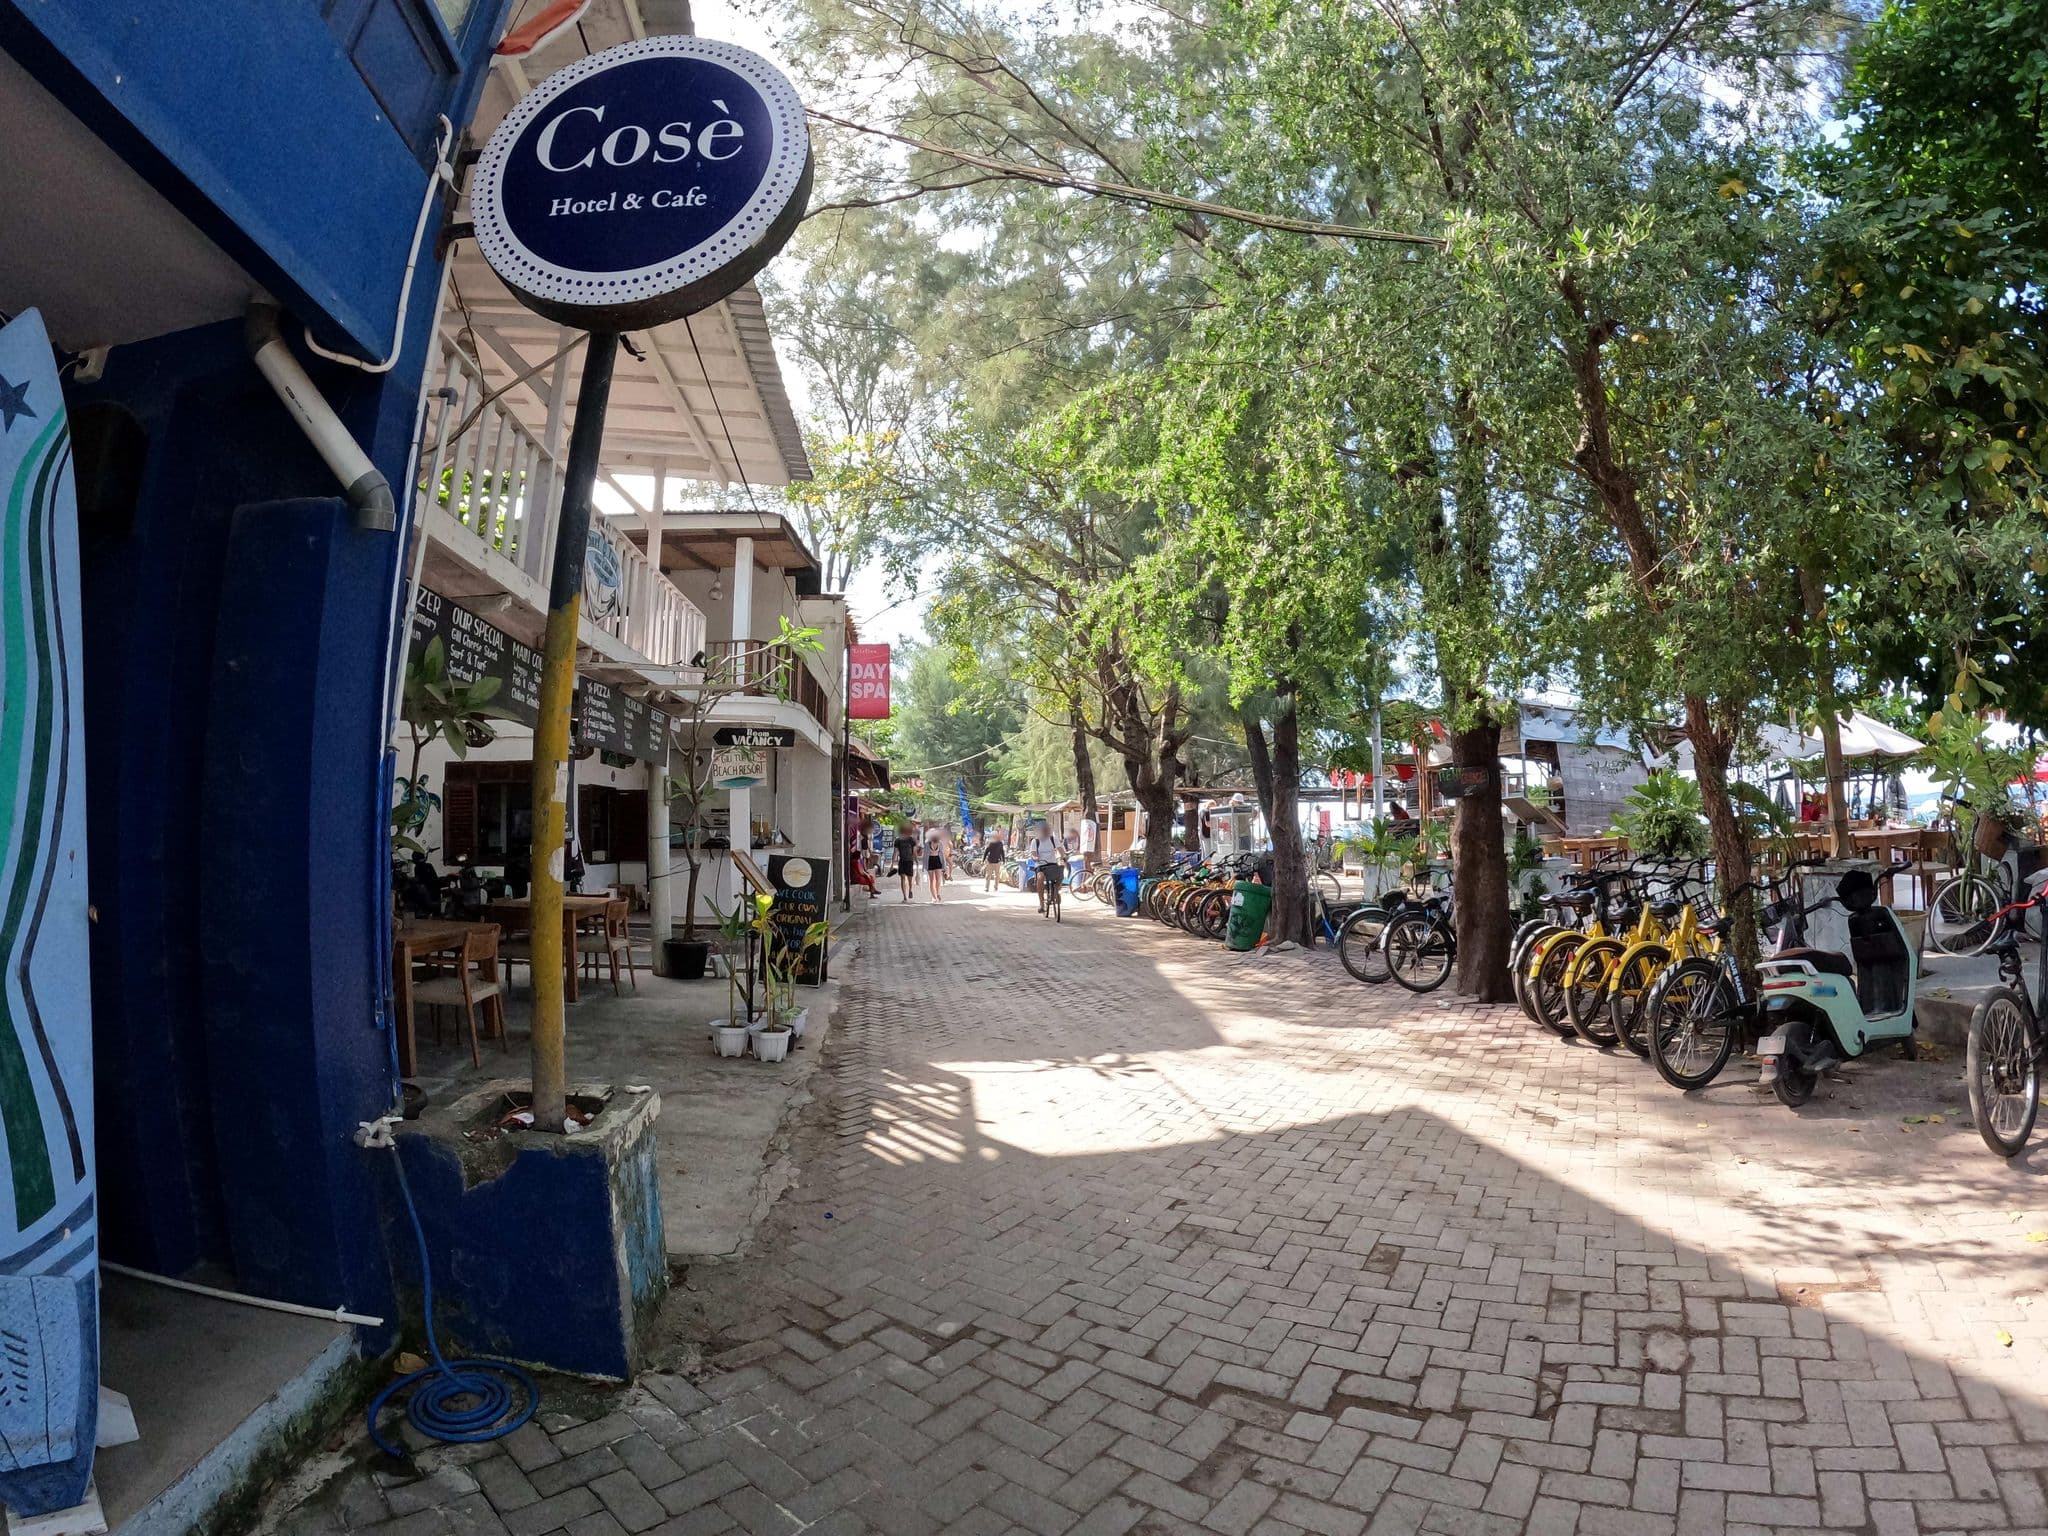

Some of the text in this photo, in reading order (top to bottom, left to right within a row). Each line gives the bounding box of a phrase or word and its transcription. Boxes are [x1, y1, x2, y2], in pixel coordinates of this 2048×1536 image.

[536, 99, 744, 173] Cosè
[549, 186, 708, 217] Hotel & Cafe
[452, 606, 505, 652] OUR SPECIAL
[450, 643, 466, 661] Surf
[466, 651, 473, 666] &
[512, 640, 531, 665] MAIN
[448, 659, 474, 683] Seafood
[851, 663, 888, 680] DAY
[593, 682, 611, 700] PIZZA
[851, 681, 888, 699] SPA
[731, 734, 784, 746] VACANCY
[746, 728, 770, 737] Room
[712, 760, 764, 777] BEACH RESORT
[791, 888, 817, 900] COOK
[797, 901, 819, 913] OWN
